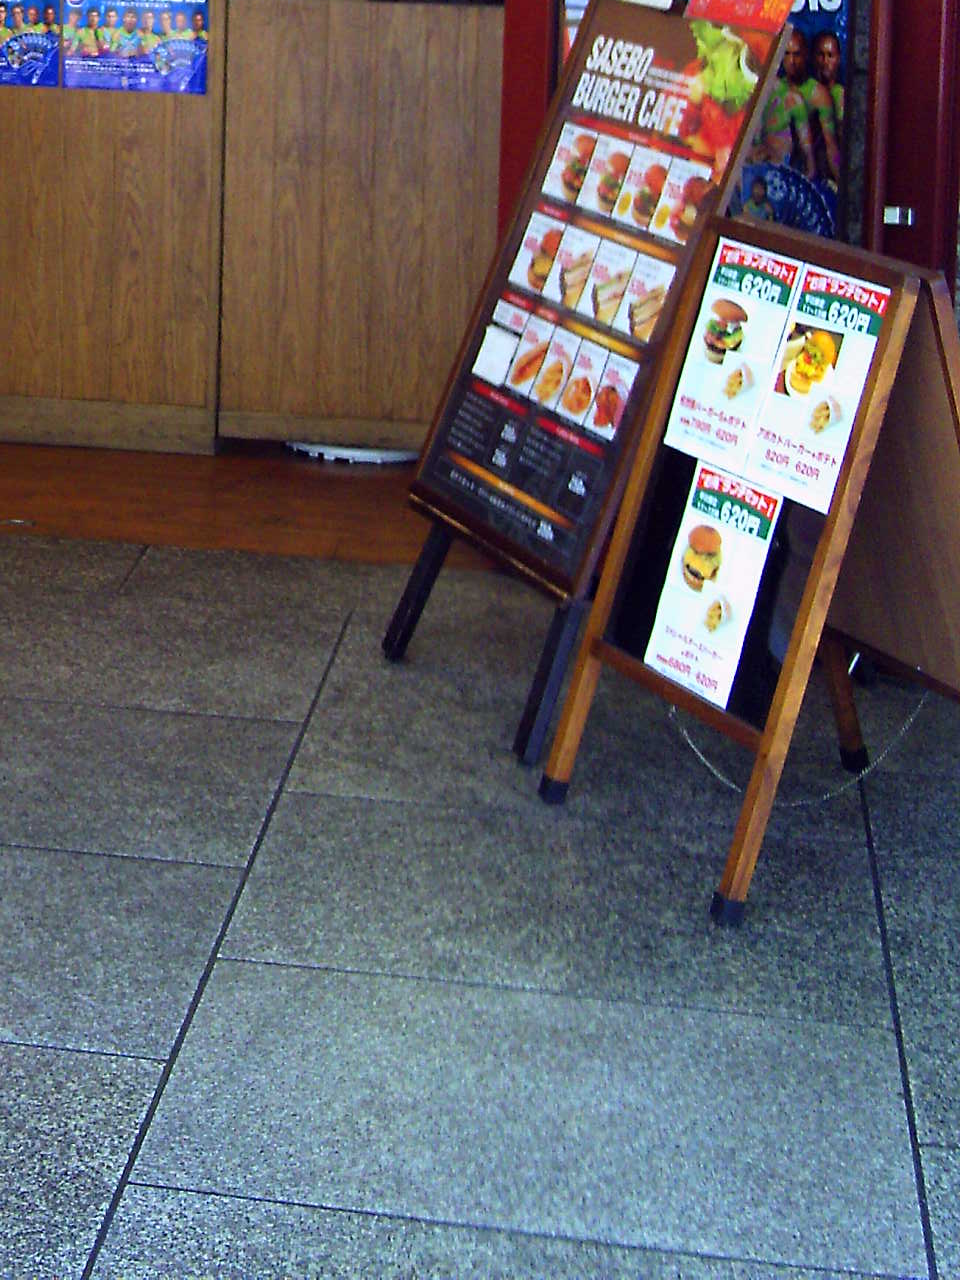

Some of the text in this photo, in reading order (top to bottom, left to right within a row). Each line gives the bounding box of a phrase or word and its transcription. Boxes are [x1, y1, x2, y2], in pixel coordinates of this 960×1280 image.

[585, 33, 654, 83] SASEBO
[571, 72, 640, 124] BURGER
[637, 89, 689, 137] CAFE
[741, 273, 782, 305] 620円
[828, 300, 871, 333] 620円
[720, 500, 761, 535] 620円
